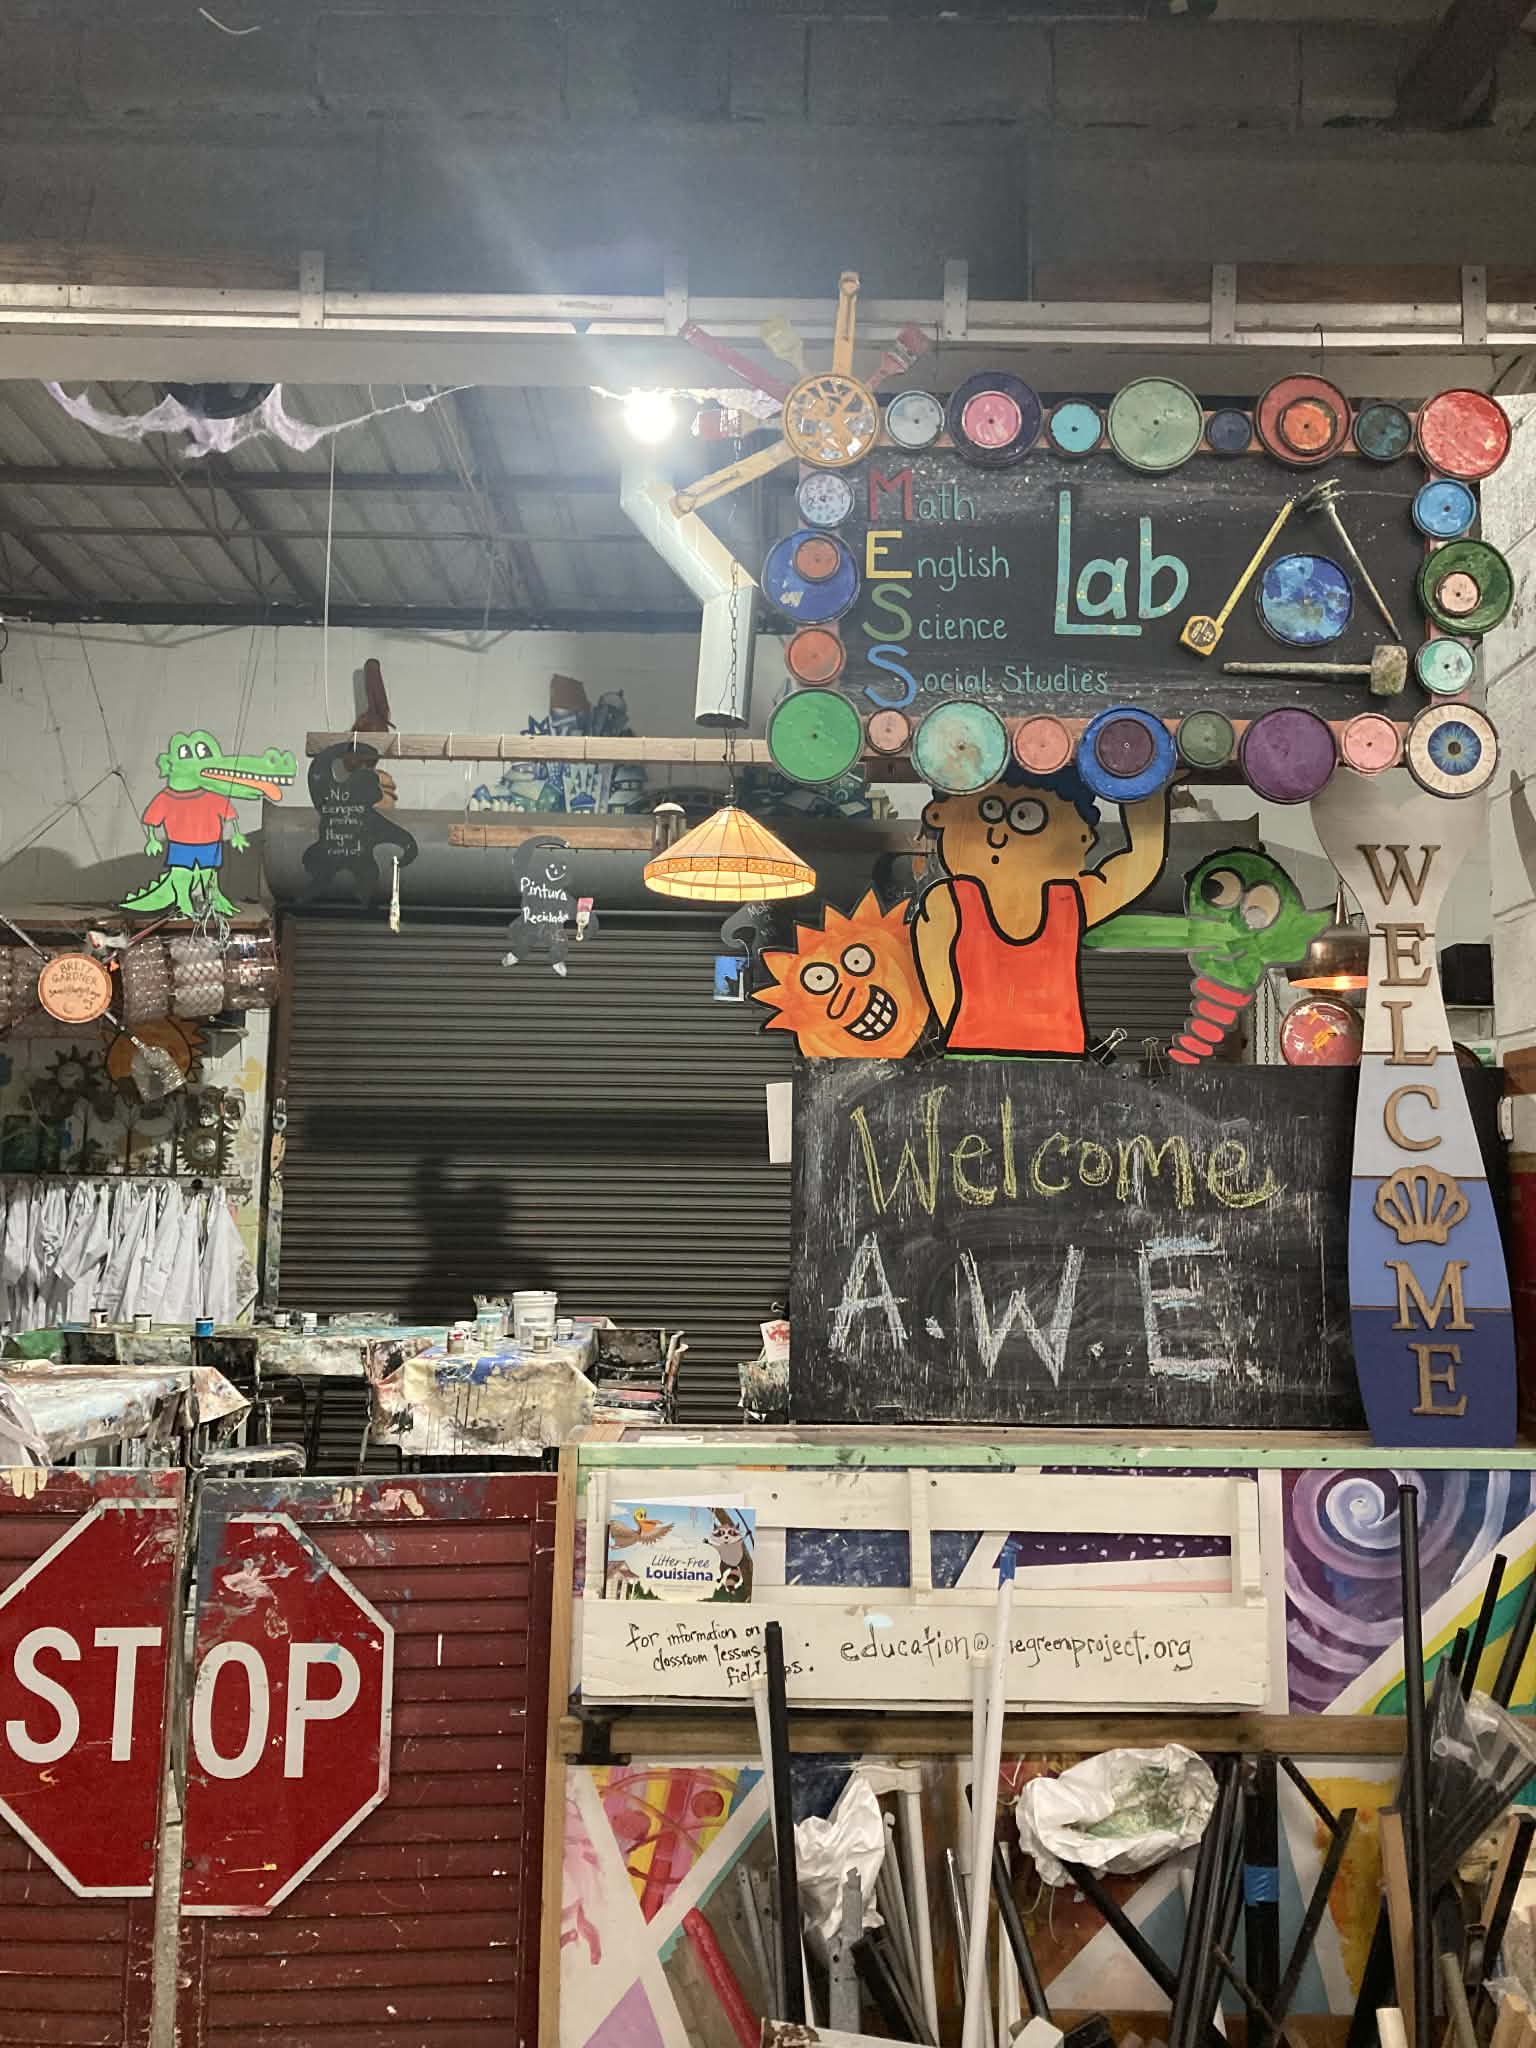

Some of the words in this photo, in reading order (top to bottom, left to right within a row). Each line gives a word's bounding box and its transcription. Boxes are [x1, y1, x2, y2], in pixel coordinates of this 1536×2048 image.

[868, 467, 976, 521] Math
[865, 530, 1010, 592] English
[1054, 489, 1190, 635] Lab
[862, 583, 1009, 642] Science
[864, 643, 992, 709] Social
[1001, 663, 1109, 694] Studies
[520, 876, 568, 901] Pintura
[850, 1085, 1289, 1216] Welcome
[645, 1566, 714, 1582] Louisiana
[651, 1553, 711, 1569] Litter-Free
[653, 1647, 709, 1672] classroom
[714, 1644, 761, 1667] lessons
[667, 1620, 737, 1648] information
[745, 1625, 761, 1638] on
[5, 1626, 362, 1780] STOP
